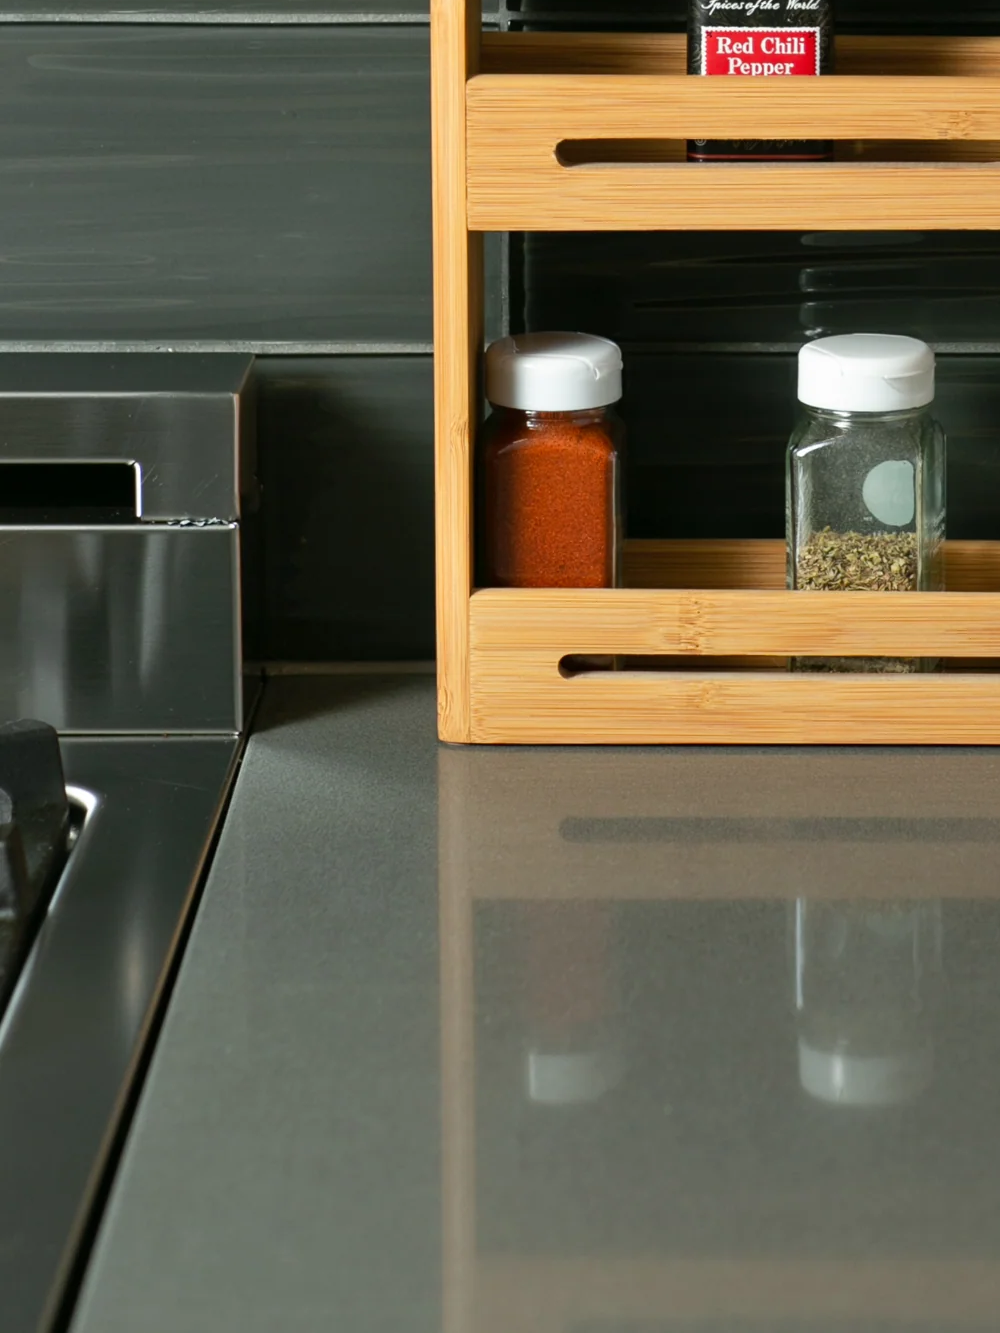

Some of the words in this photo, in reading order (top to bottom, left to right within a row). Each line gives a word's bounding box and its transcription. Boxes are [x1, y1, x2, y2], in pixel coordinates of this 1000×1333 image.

[716, 37, 754, 54] Red
[761, 37, 805, 54] Chili
[728, 57, 794, 75] Pepper
